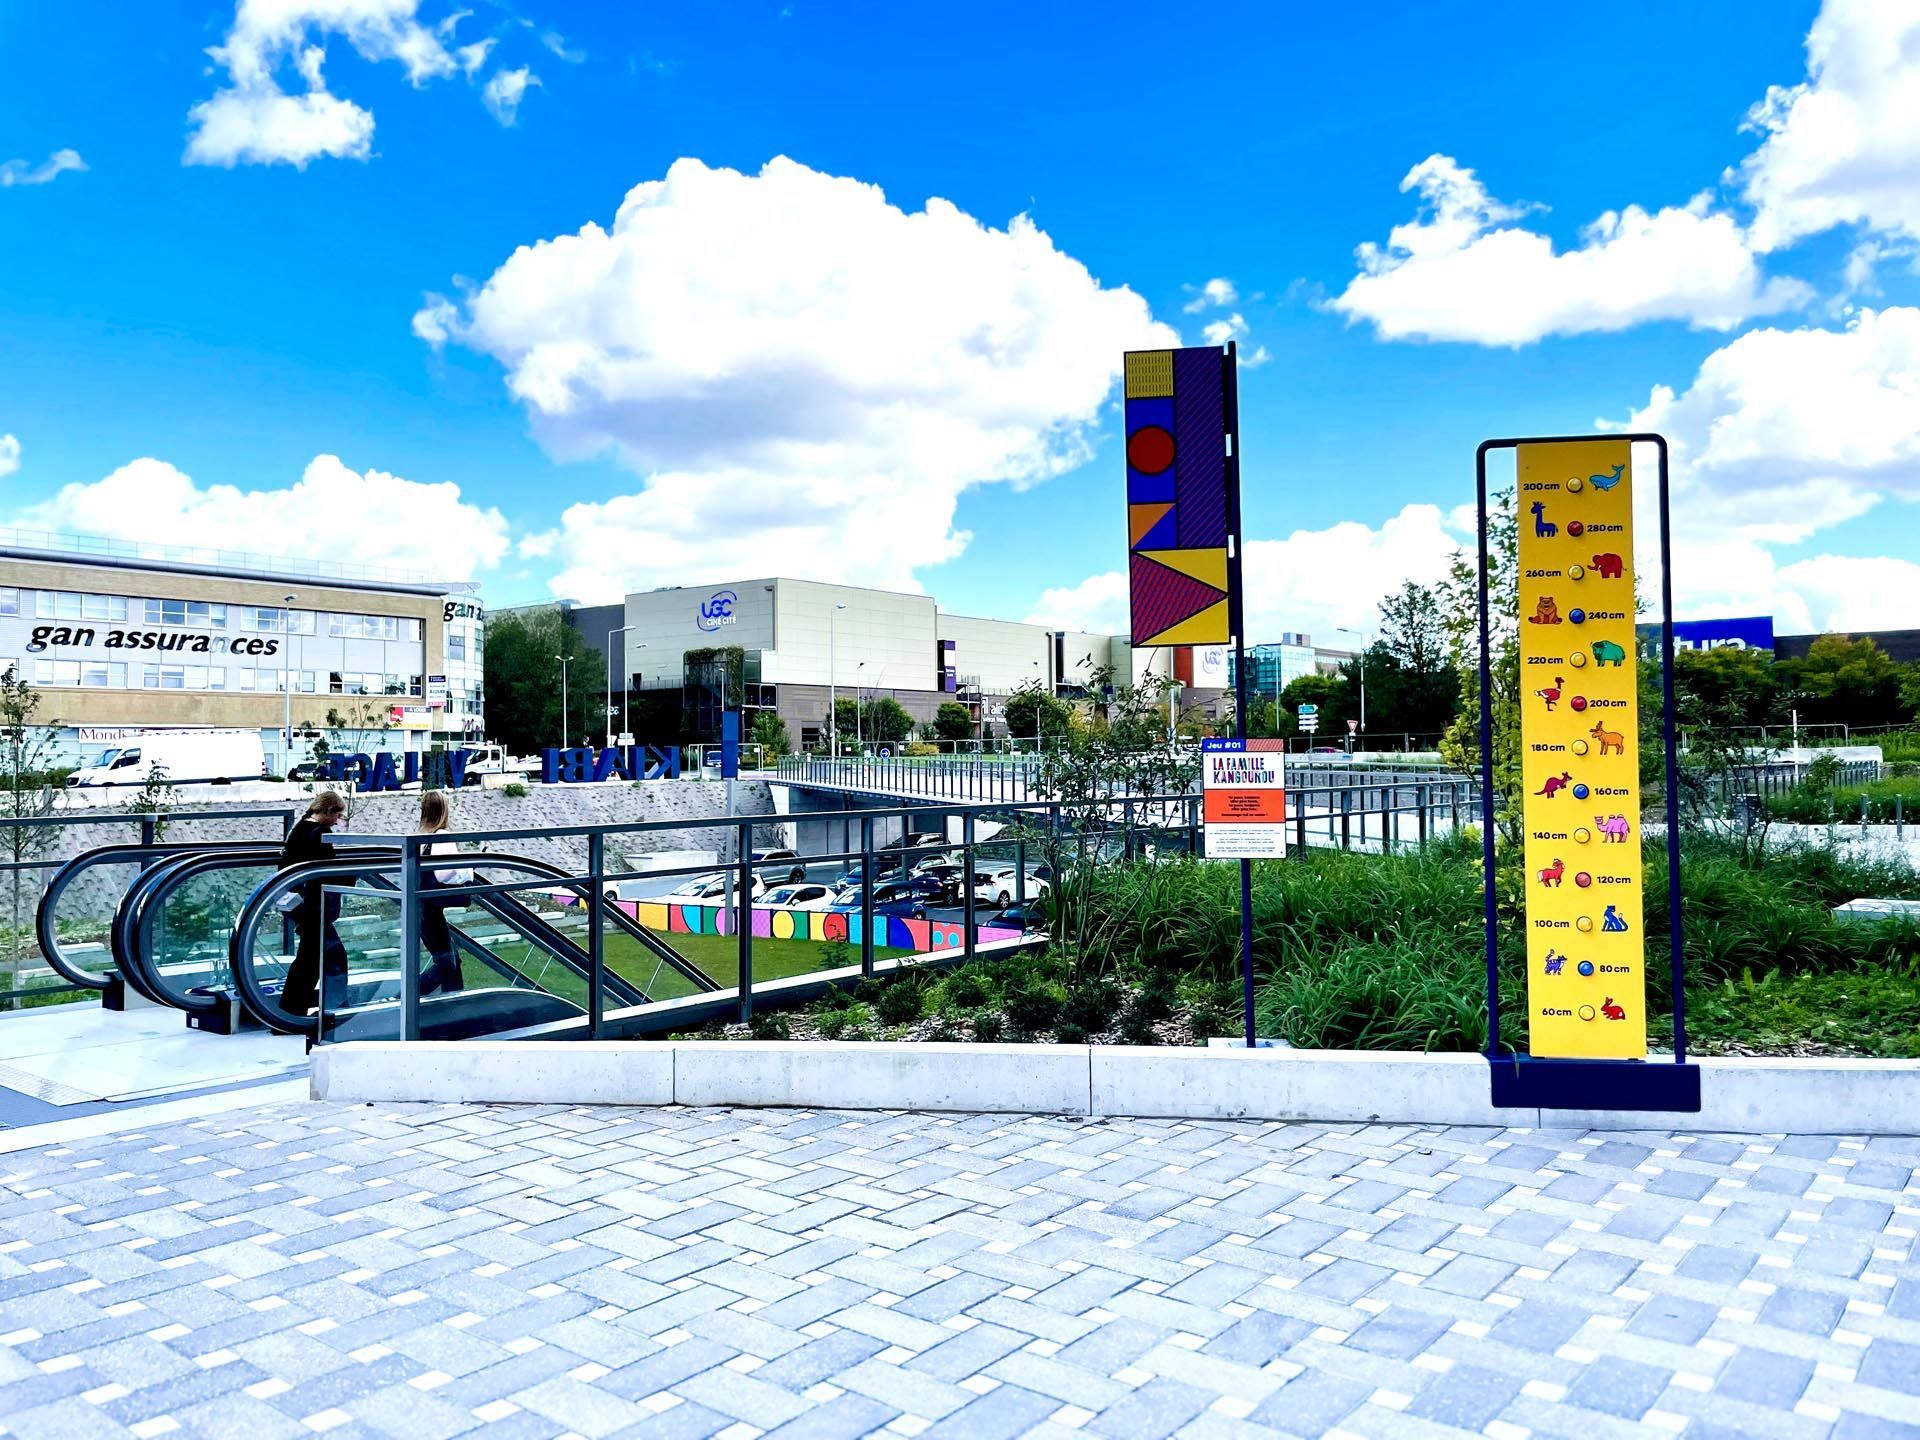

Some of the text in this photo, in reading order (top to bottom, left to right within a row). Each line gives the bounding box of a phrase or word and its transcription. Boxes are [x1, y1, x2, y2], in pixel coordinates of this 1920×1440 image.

[1523, 482, 1560, 491] 300 cm
[1586, 523, 1624, 533] 280 cm
[1525, 569, 1562, 578] 260 cm
[443, 602, 475, 622] gan
[702, 599, 731, 618] UGC
[1587, 611, 1625, 620] 240 cm
[26, 626, 279, 656] gan assurances
[1527, 656, 1564, 665] 220 cm
[1589, 699, 1627, 708] 200 cm
[1206, 741, 1241, 750] Jeu #01
[1531, 743, 1566, 752] 180 cm
[1213, 757, 1265, 770] LA FAMILLE
[1213, 770, 1275, 784] KANGOUROU
[1594, 787, 1629, 796] 160 cm
[1532, 831, 1568, 840] 140 cm
[1596, 875, 1632, 884] 120 cm
[1534, 919, 1570, 928] 100 cm
[1599, 964, 1630, 973] 80 cm
[1542, 1007, 1572, 1017] 60 cm
